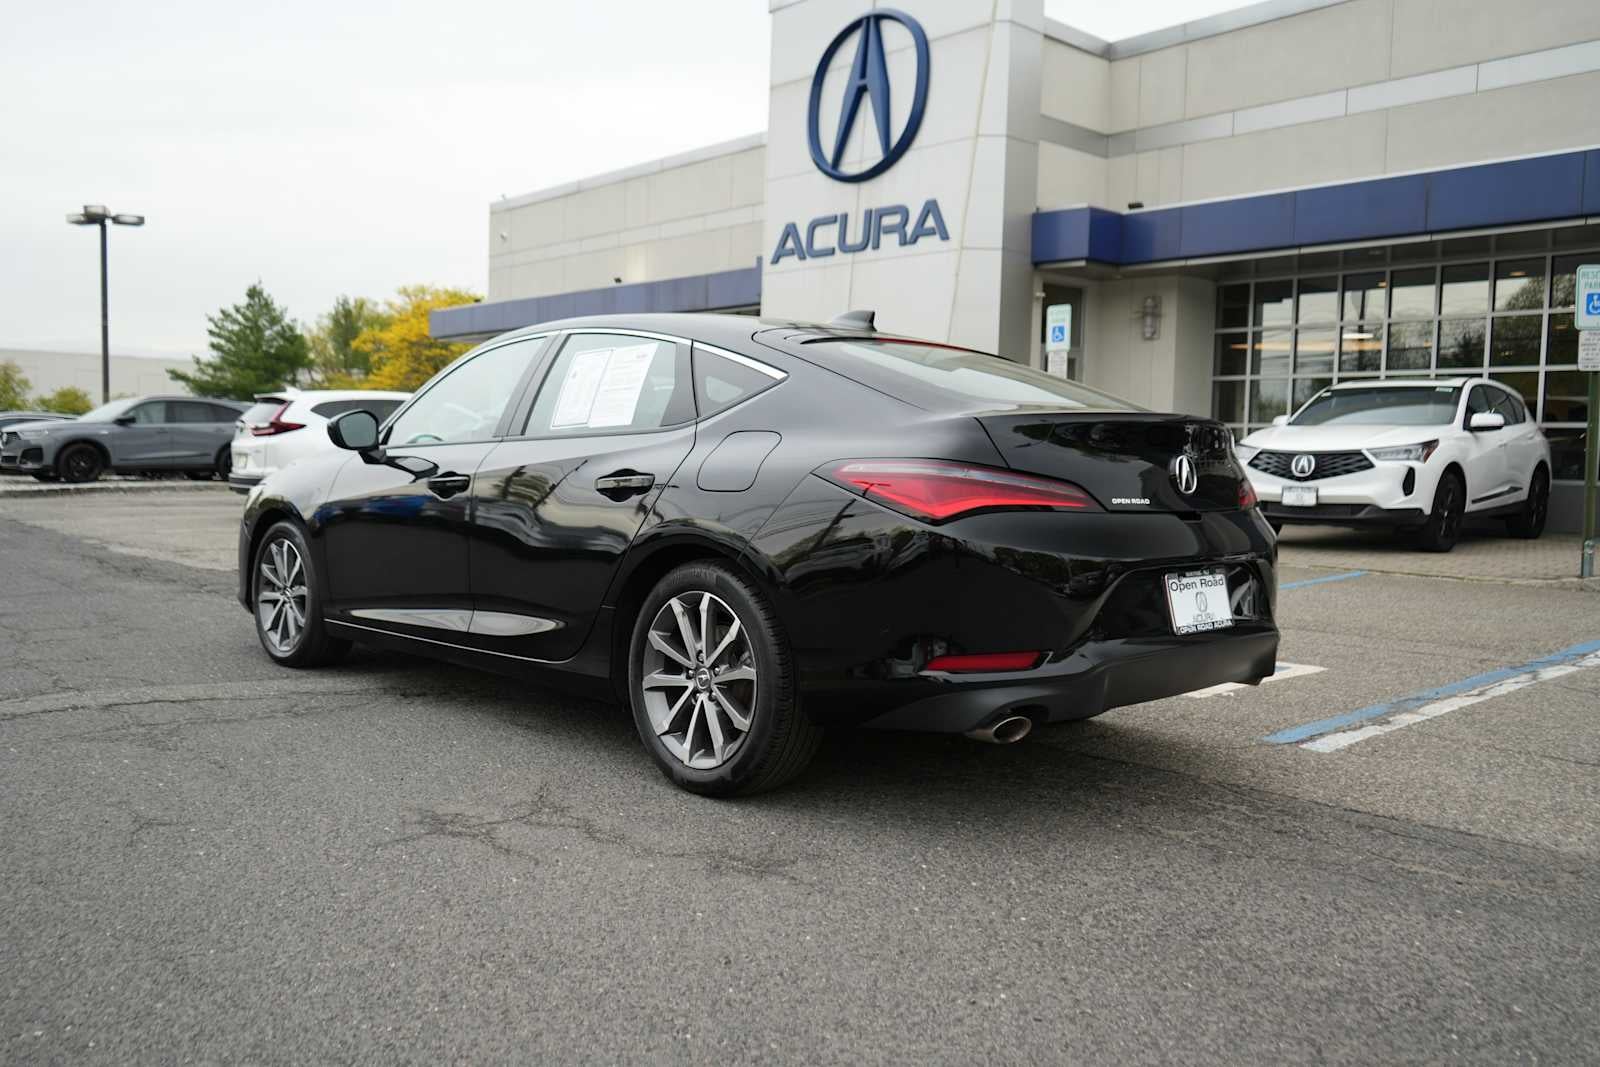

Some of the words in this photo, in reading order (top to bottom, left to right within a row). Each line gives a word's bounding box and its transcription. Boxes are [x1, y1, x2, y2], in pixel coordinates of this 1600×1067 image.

[770, 198, 950, 265] ACURA
[1170, 581, 1197, 592] Open
[1200, 577, 1224, 588] Road
[1180, 625, 1197, 634] OPEN
[1197, 623, 1214, 631] ROAD
[1214, 619, 1233, 628] ACURA
